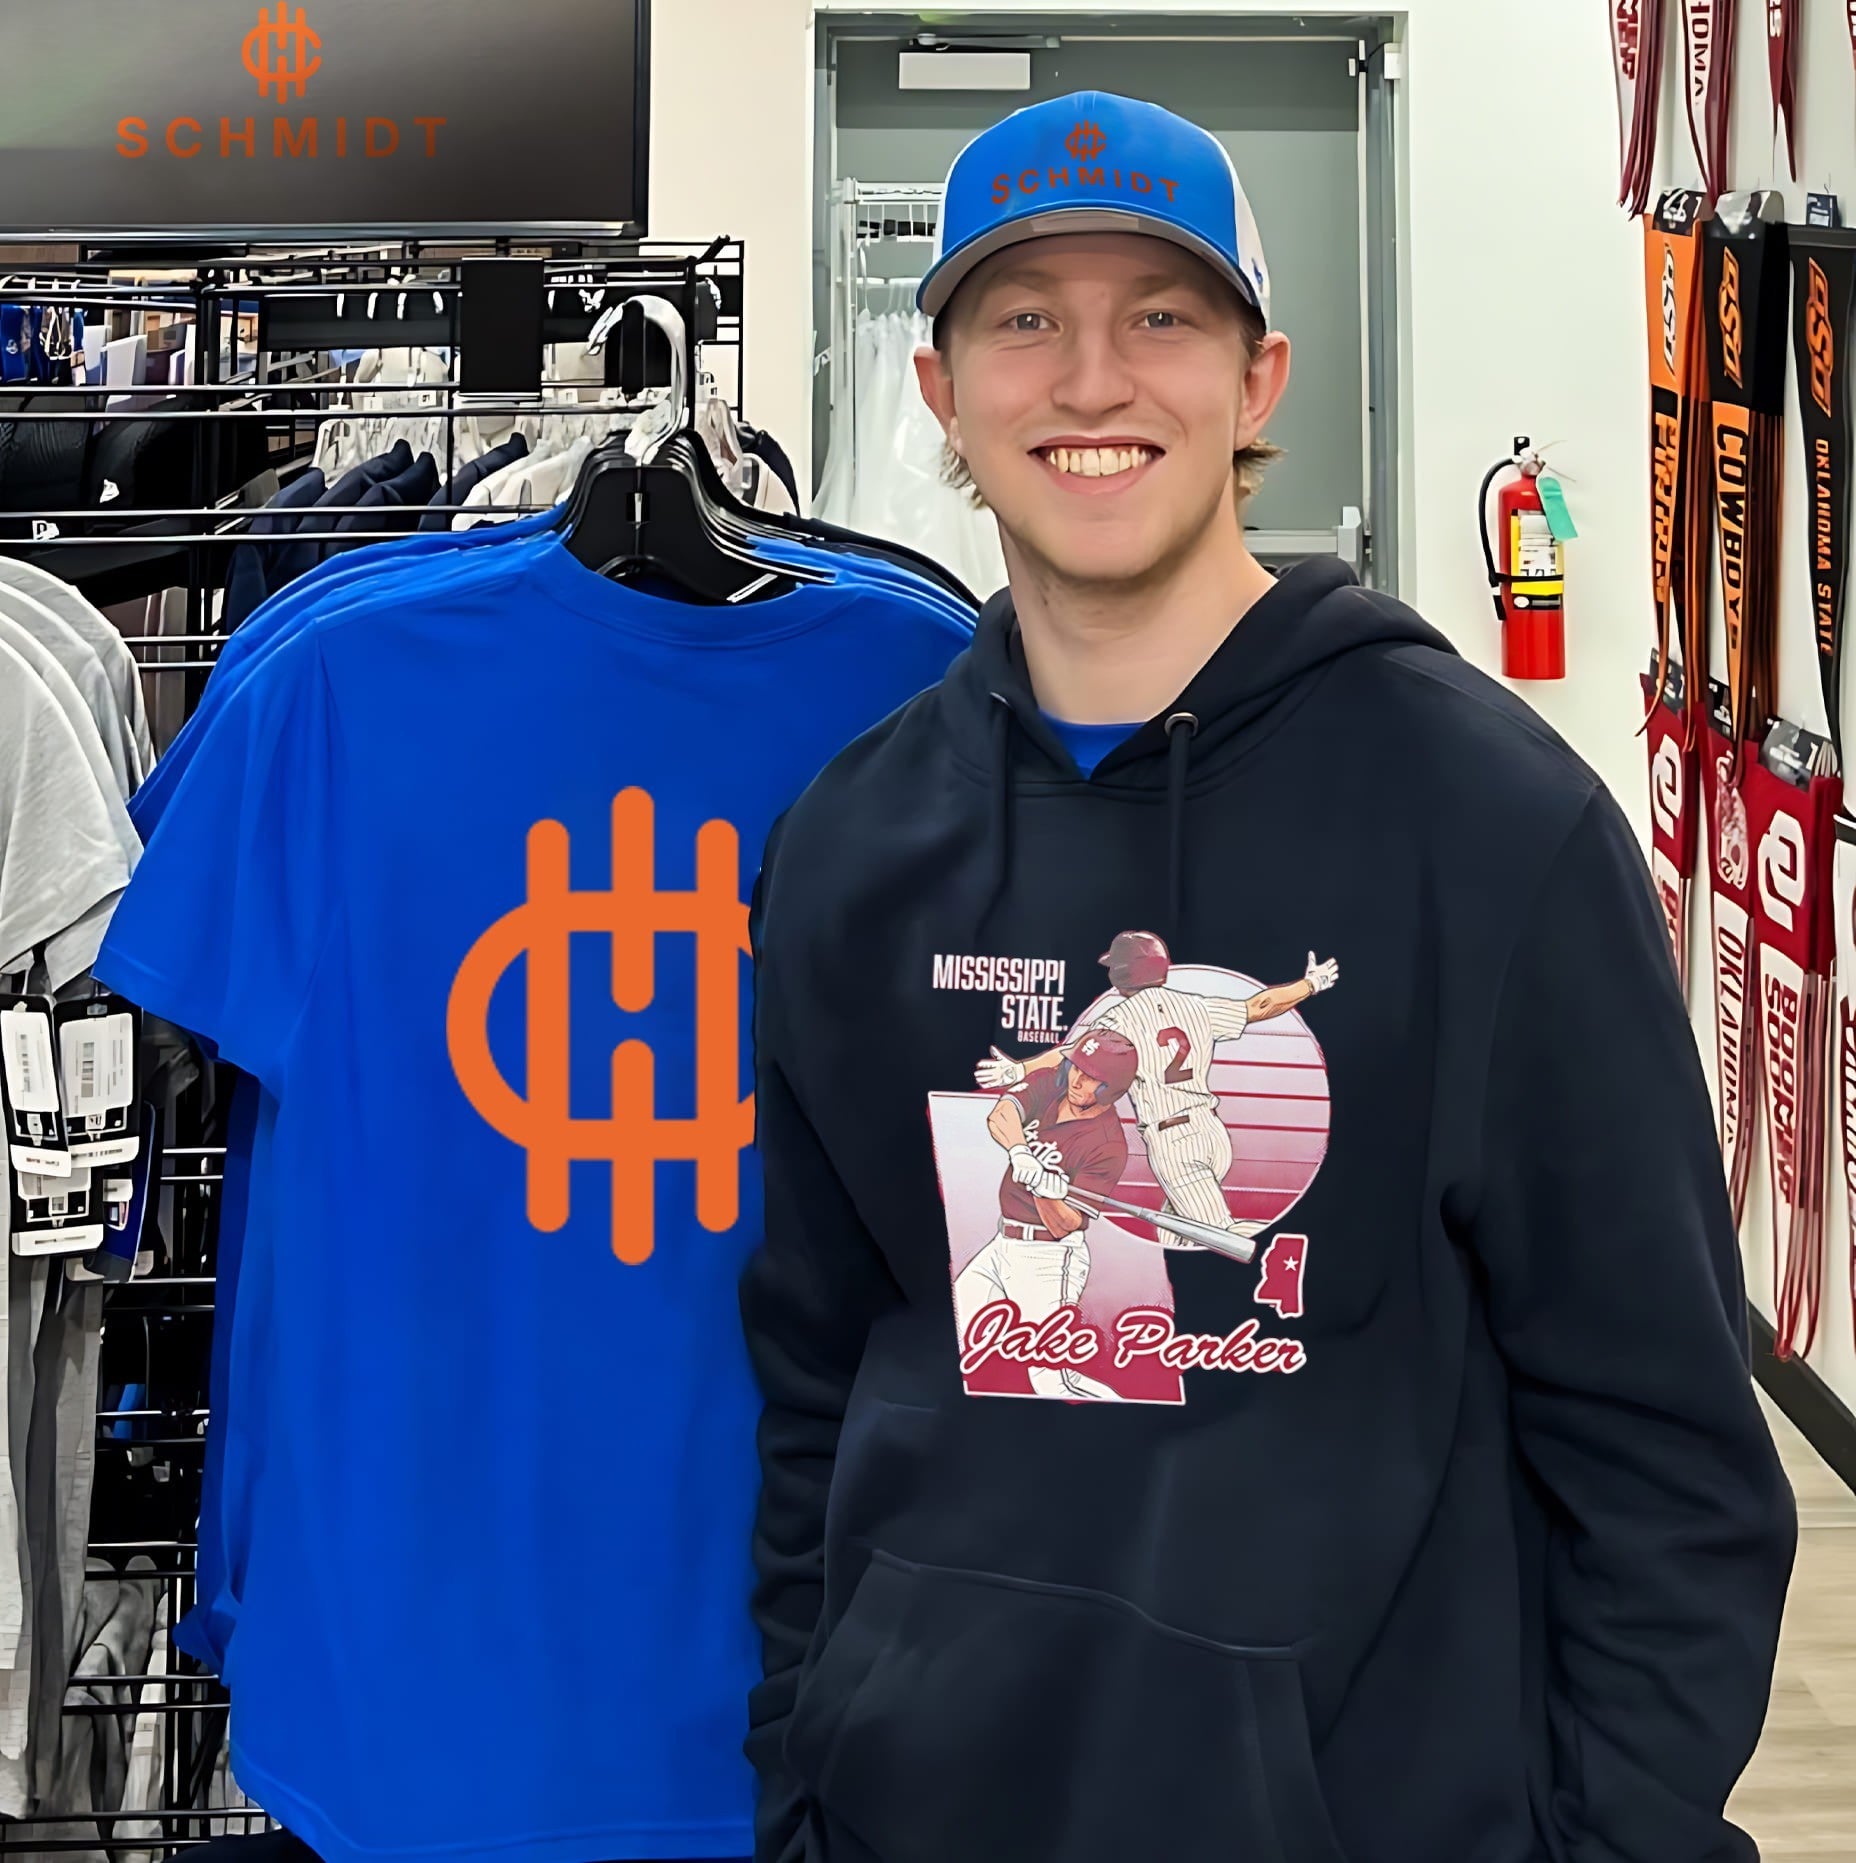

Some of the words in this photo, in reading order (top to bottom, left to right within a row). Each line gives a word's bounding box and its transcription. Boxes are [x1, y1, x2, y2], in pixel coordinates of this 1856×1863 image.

[115, 116, 448, 159] SCHMIDT
[991, 166, 1180, 205] SCHMIDT
[1815, 438, 1833, 570] OKLAHOMA
[932, 953, 1066, 995] MISSISSIPPI
[1016, 1030, 1060, 1044] BASEBALL
[1157, 1026, 1193, 1084] 2
[960, 1299, 1099, 1374] Jake
[1114, 1309, 1307, 1374] Parker
